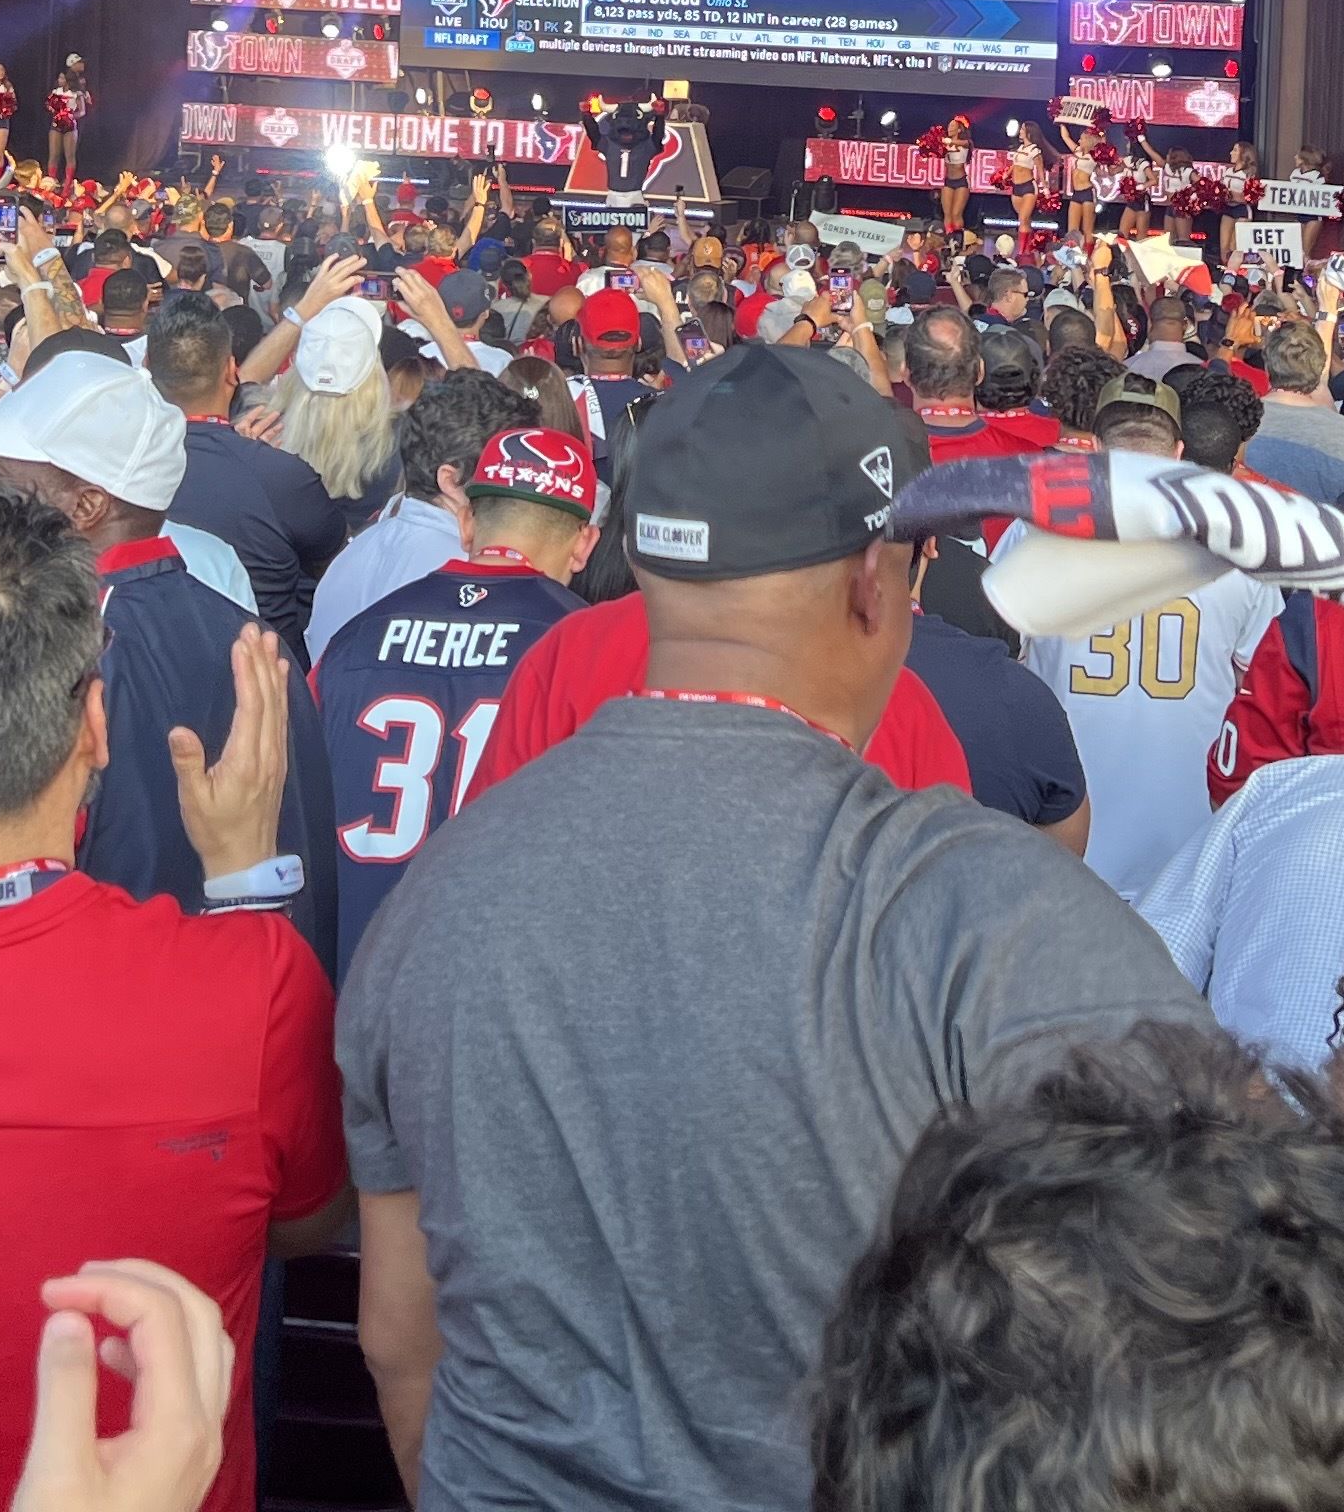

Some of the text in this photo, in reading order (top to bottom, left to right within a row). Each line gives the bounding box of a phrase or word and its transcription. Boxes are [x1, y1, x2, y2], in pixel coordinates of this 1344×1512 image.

[435, 16, 462, 27] LIVE
[480, 18, 508, 30] HOU
[517, 19, 573, 34] RD 1 PK 2
[594, 6, 898, 32] 8,123 pass yds, 85 TD, 12 INT in career (28 games)
[434, 32, 489, 46] NFL DRAFT
[621, 26, 637, 36] ARI
[647, 28, 663, 38] IND
[673, 29, 690, 39] SEA
[700, 30, 718, 40] DET
[729, 32, 742, 42] LV
[754, 33, 772, 43] ATL
[783, 34, 799, 44] CHI
[811, 36, 827, 46] PHI
[838, 37, 856, 47] TEN
[866, 38, 885, 48] HOU
[897, 40, 912, 50] GB
[926, 41, 940, 51] NE
[953, 42, 972, 53] NYJ
[982, 44, 1002, 54] WAS
[1014, 45, 1030, 55] PIT
[539, 38, 580, 52] multiple
[581, 41, 622, 53] devices
[624, 42, 665, 56] through
[667, 44, 691, 57] LIVE
[693, 45, 748, 61] streaming
[750, 47, 779, 61] video
[781, 52, 796, 63] on
[797, 51, 818, 64] NFL
[820, 52, 871, 68] Network,
[321, 112, 458, 154] WELCOME
[470, 120, 504, 157] TO
[619, 150, 630, 178] 1
[839, 140, 997, 190] WELCOE
[1269, 186, 1332, 210] TEXANS
[581, 211, 646, 227] HOUSTON
[823, 222, 886, 244] SOMOS TEXANS
[1252, 228, 1285, 245] GET
[483, 463, 585, 499] TEXANS
[639, 521, 661, 542] BLACK
[377, 618, 521, 669] PIERCE
[1069, 596, 1200, 701] 30
[336, 693, 502, 865] 31
